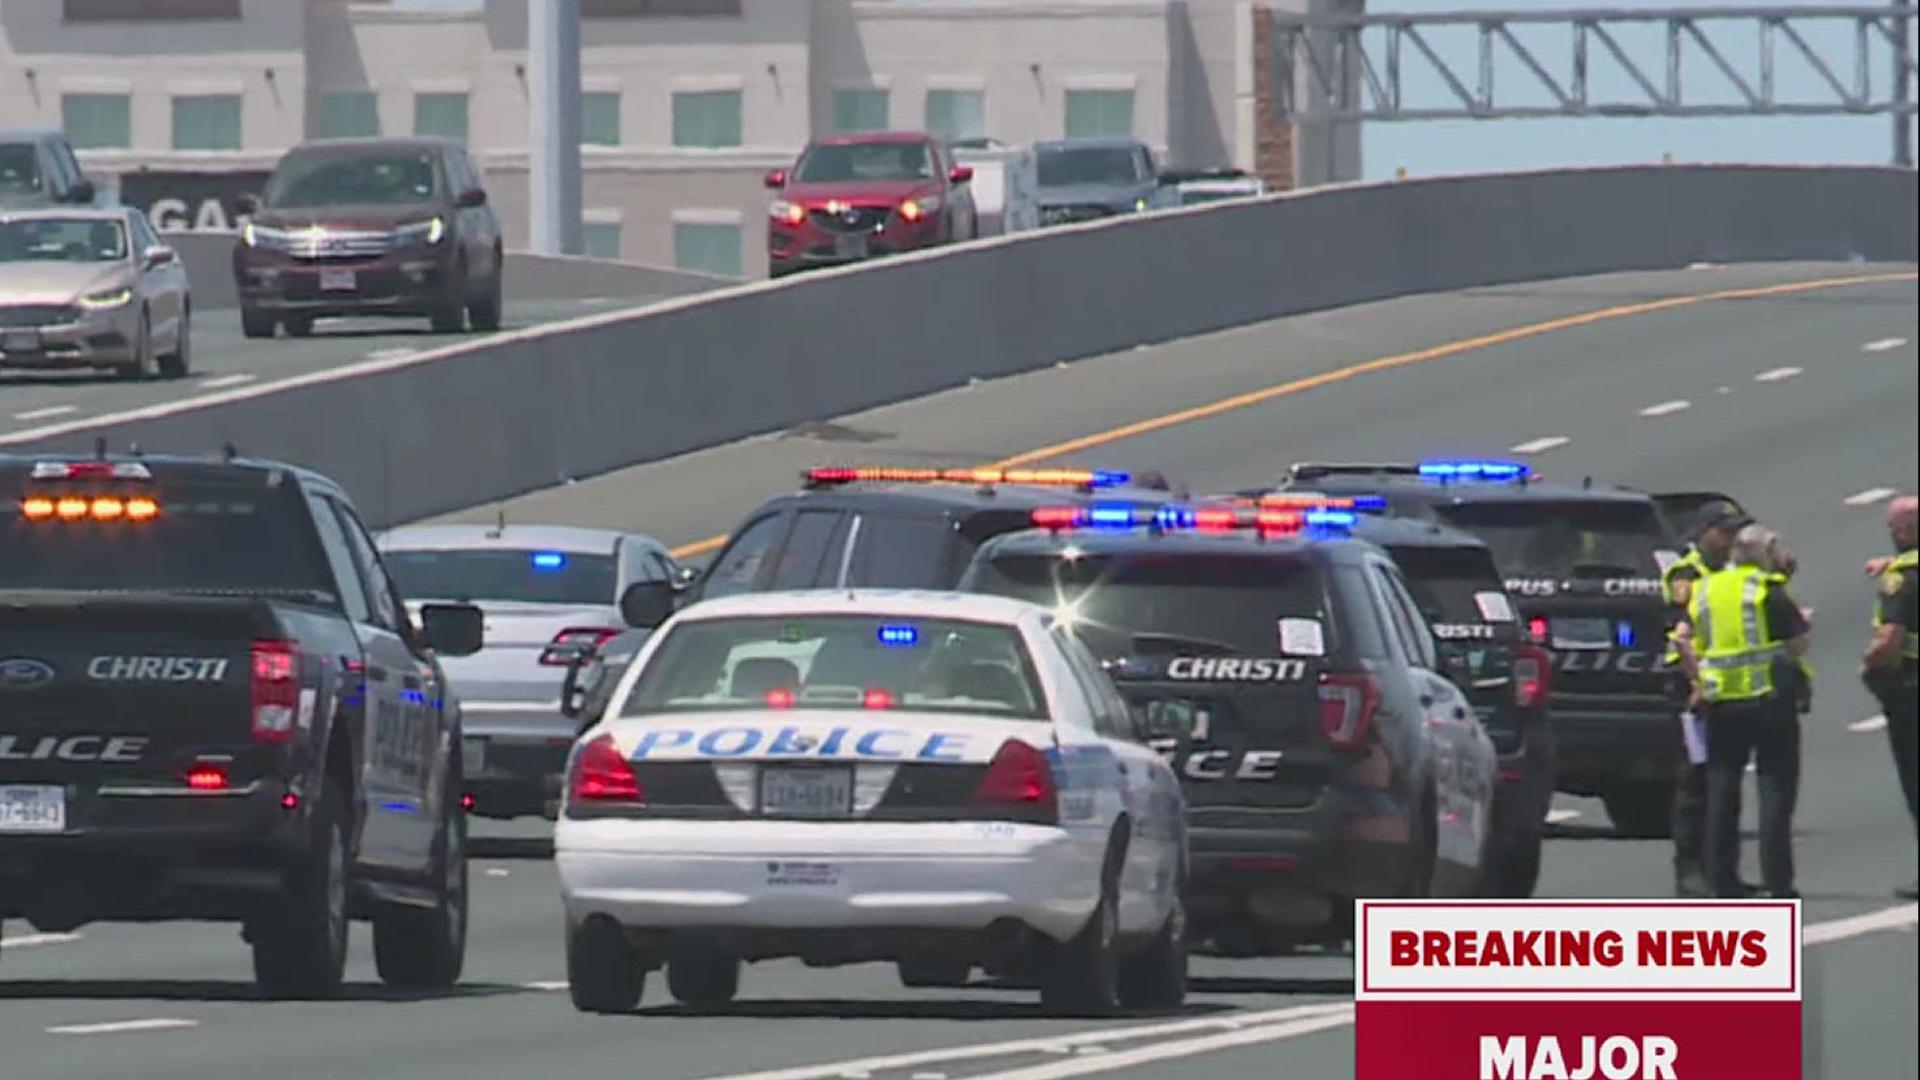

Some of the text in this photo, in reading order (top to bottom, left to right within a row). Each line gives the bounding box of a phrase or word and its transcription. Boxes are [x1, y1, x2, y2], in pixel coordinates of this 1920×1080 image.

[86, 655, 229, 681] CHRISTI
[1167, 656, 1307, 681] CHRISTI
[631, 727, 973, 760] POLICE
